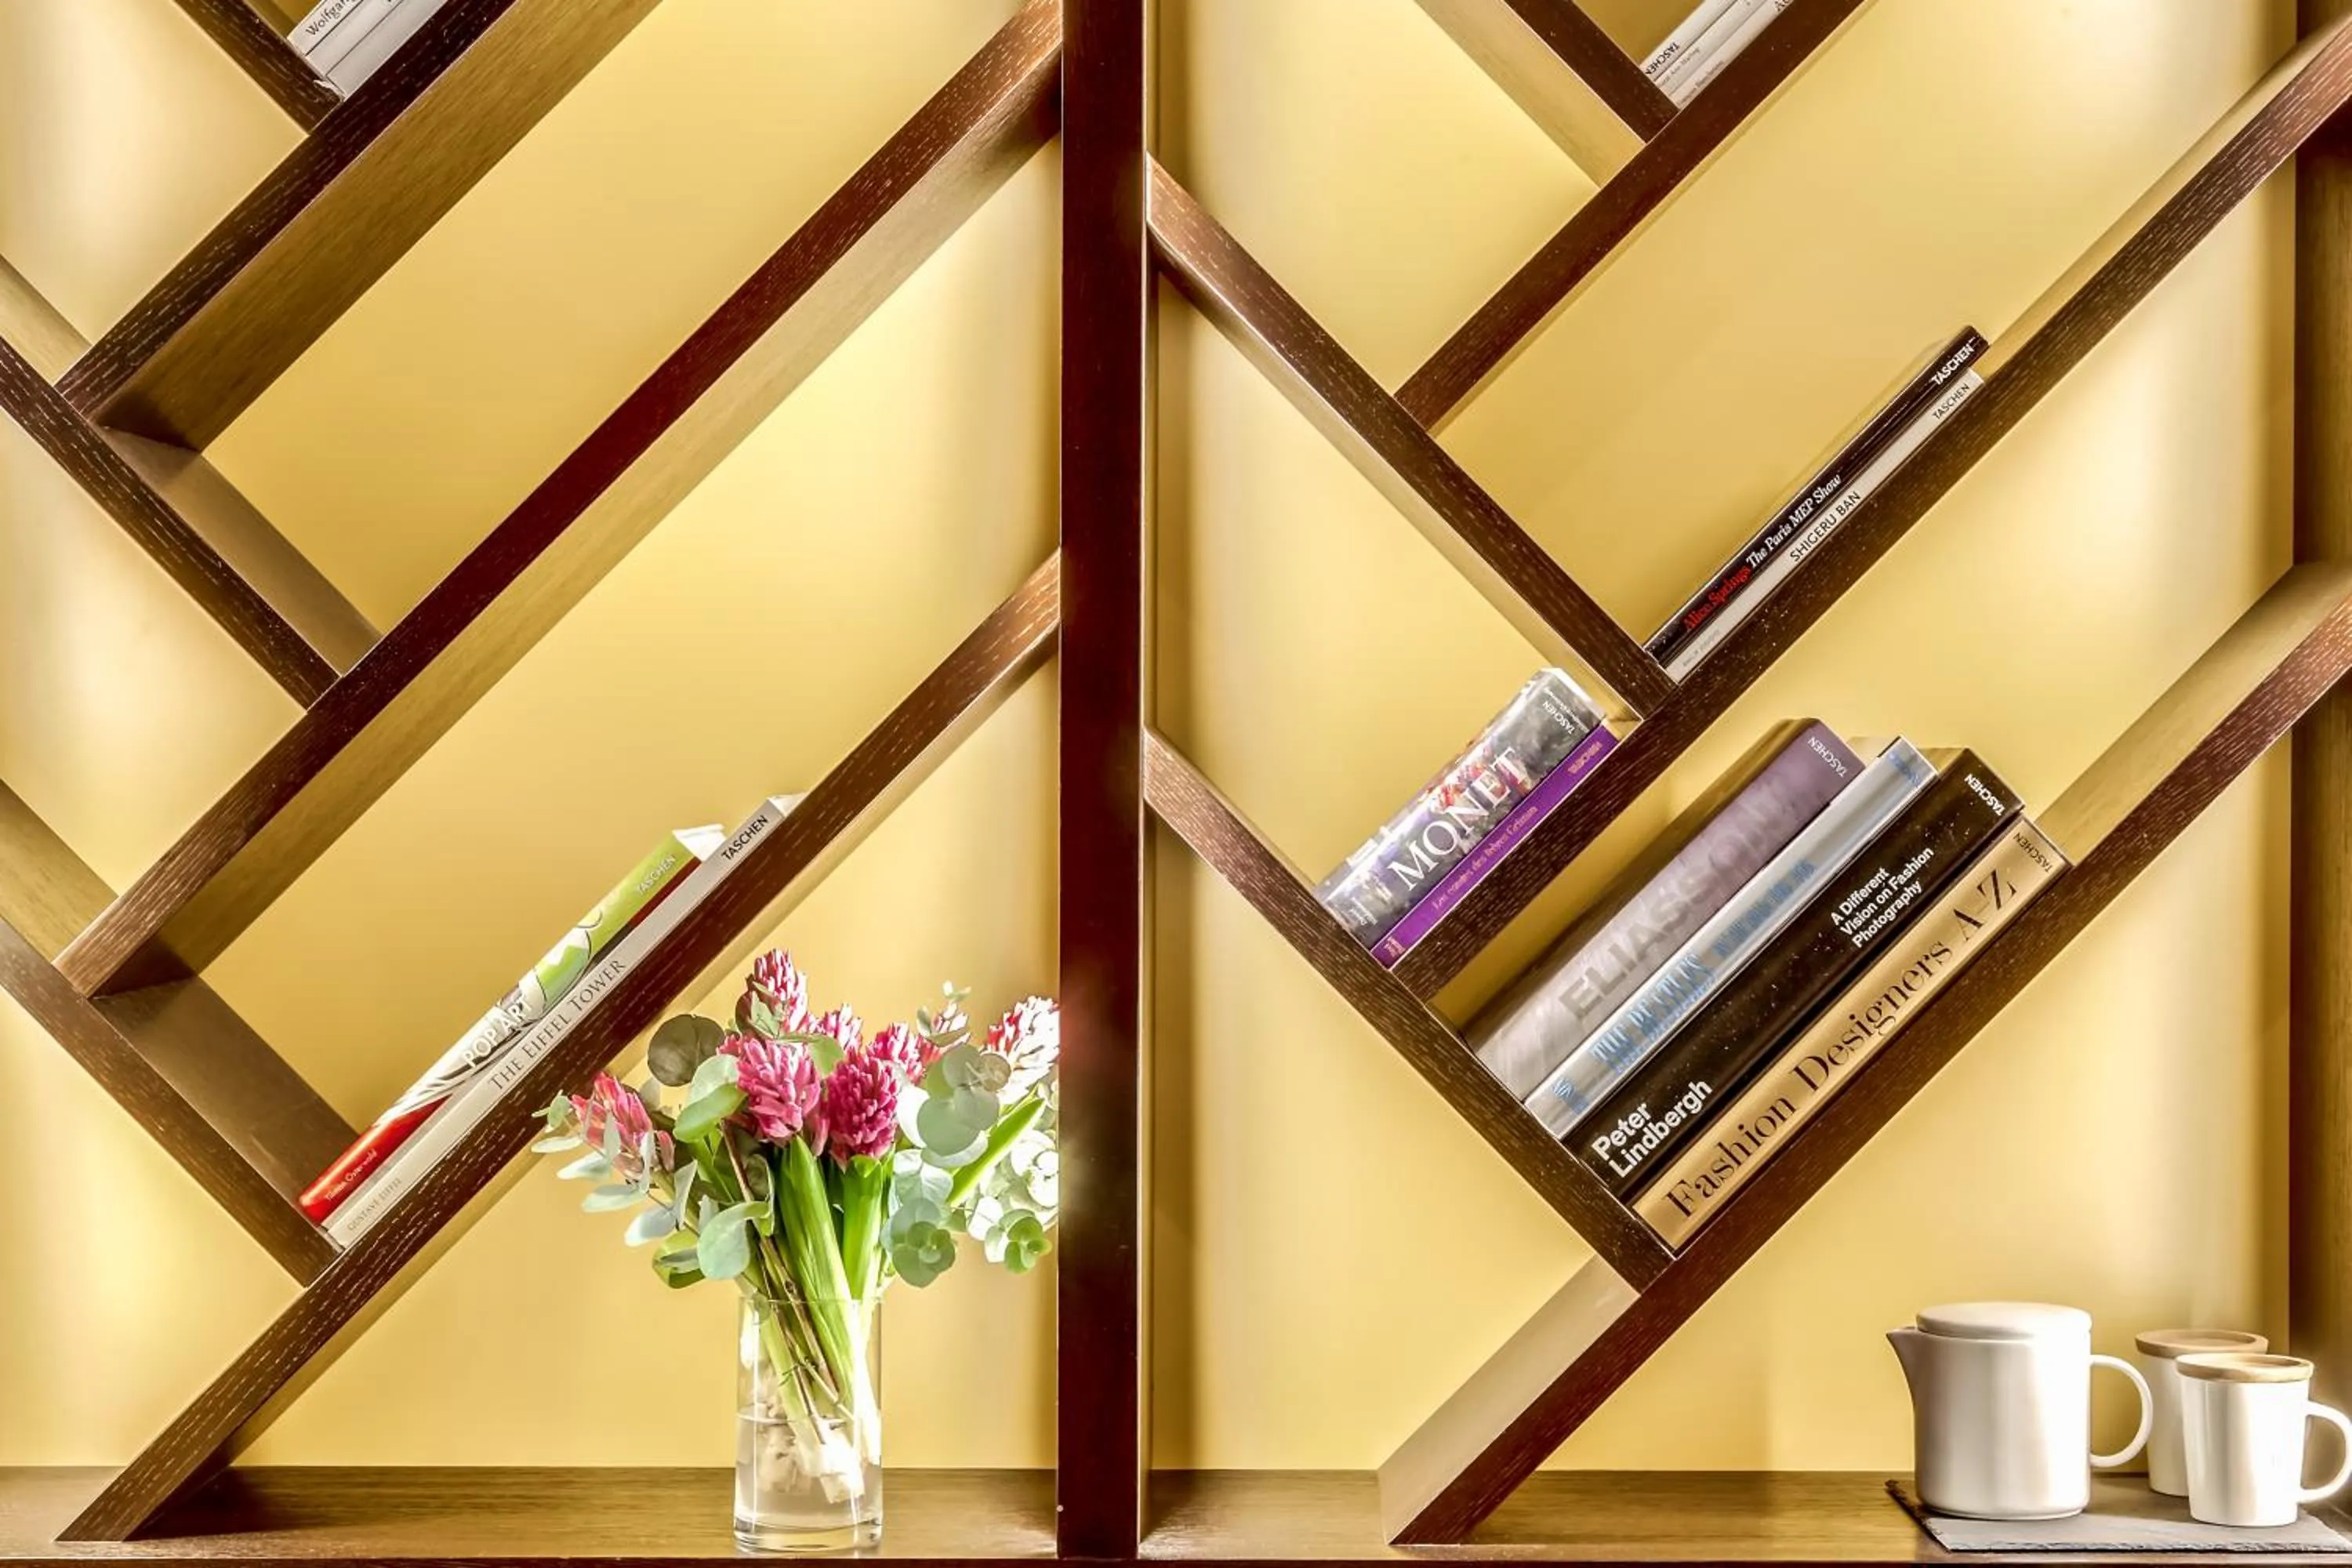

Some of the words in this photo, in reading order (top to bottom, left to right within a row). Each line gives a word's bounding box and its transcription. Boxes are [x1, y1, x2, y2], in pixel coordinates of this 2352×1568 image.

[305, 0, 355, 35] Wolfgan
[1930, 343, 1975, 387] TASCHEN
[1931, 382, 1970, 421] TASCHEN
[1744, 544, 1769, 569] The
[1762, 521, 1793, 551] Paris
[1786, 496, 1817, 528] MEP
[1809, 470, 1843, 504] Show
[1788, 512, 1838, 563] SHIGERU
[1834, 489, 1861, 517] BAN
[1541, 699, 1576, 735] TASCHEN
[1806, 734, 1849, 779] TASCHEN
[1384, 746, 1536, 892] MONET
[1963, 771, 2007, 816] TASCHEN
[720, 814, 770, 862] TASCHEN
[2012, 829, 2054, 873] TASCHEN
[634, 853, 679, 895] TASCHEN
[1828, 909, 1845, 926] A
[1838, 865, 1890, 916] Different
[1838, 898, 1879, 938] Vision
[1874, 886, 1893, 906] on
[1886, 844, 1935, 891] Fashion
[1850, 877, 1926, 950] Photography
[459, 1025, 504, 1069] POP
[493, 993, 535, 1034] ART
[487, 1056, 524, 1093] THE
[521, 1009, 572, 1060] EIFFEL
[566, 955, 627, 1014] TOWER
[1660, 1086, 1801, 1222] Fashion
[1788, 933, 1962, 1102] Designers
[1589, 1098, 1656, 1162] Peter
[1606, 1074, 1718, 1182] Lindbergh
